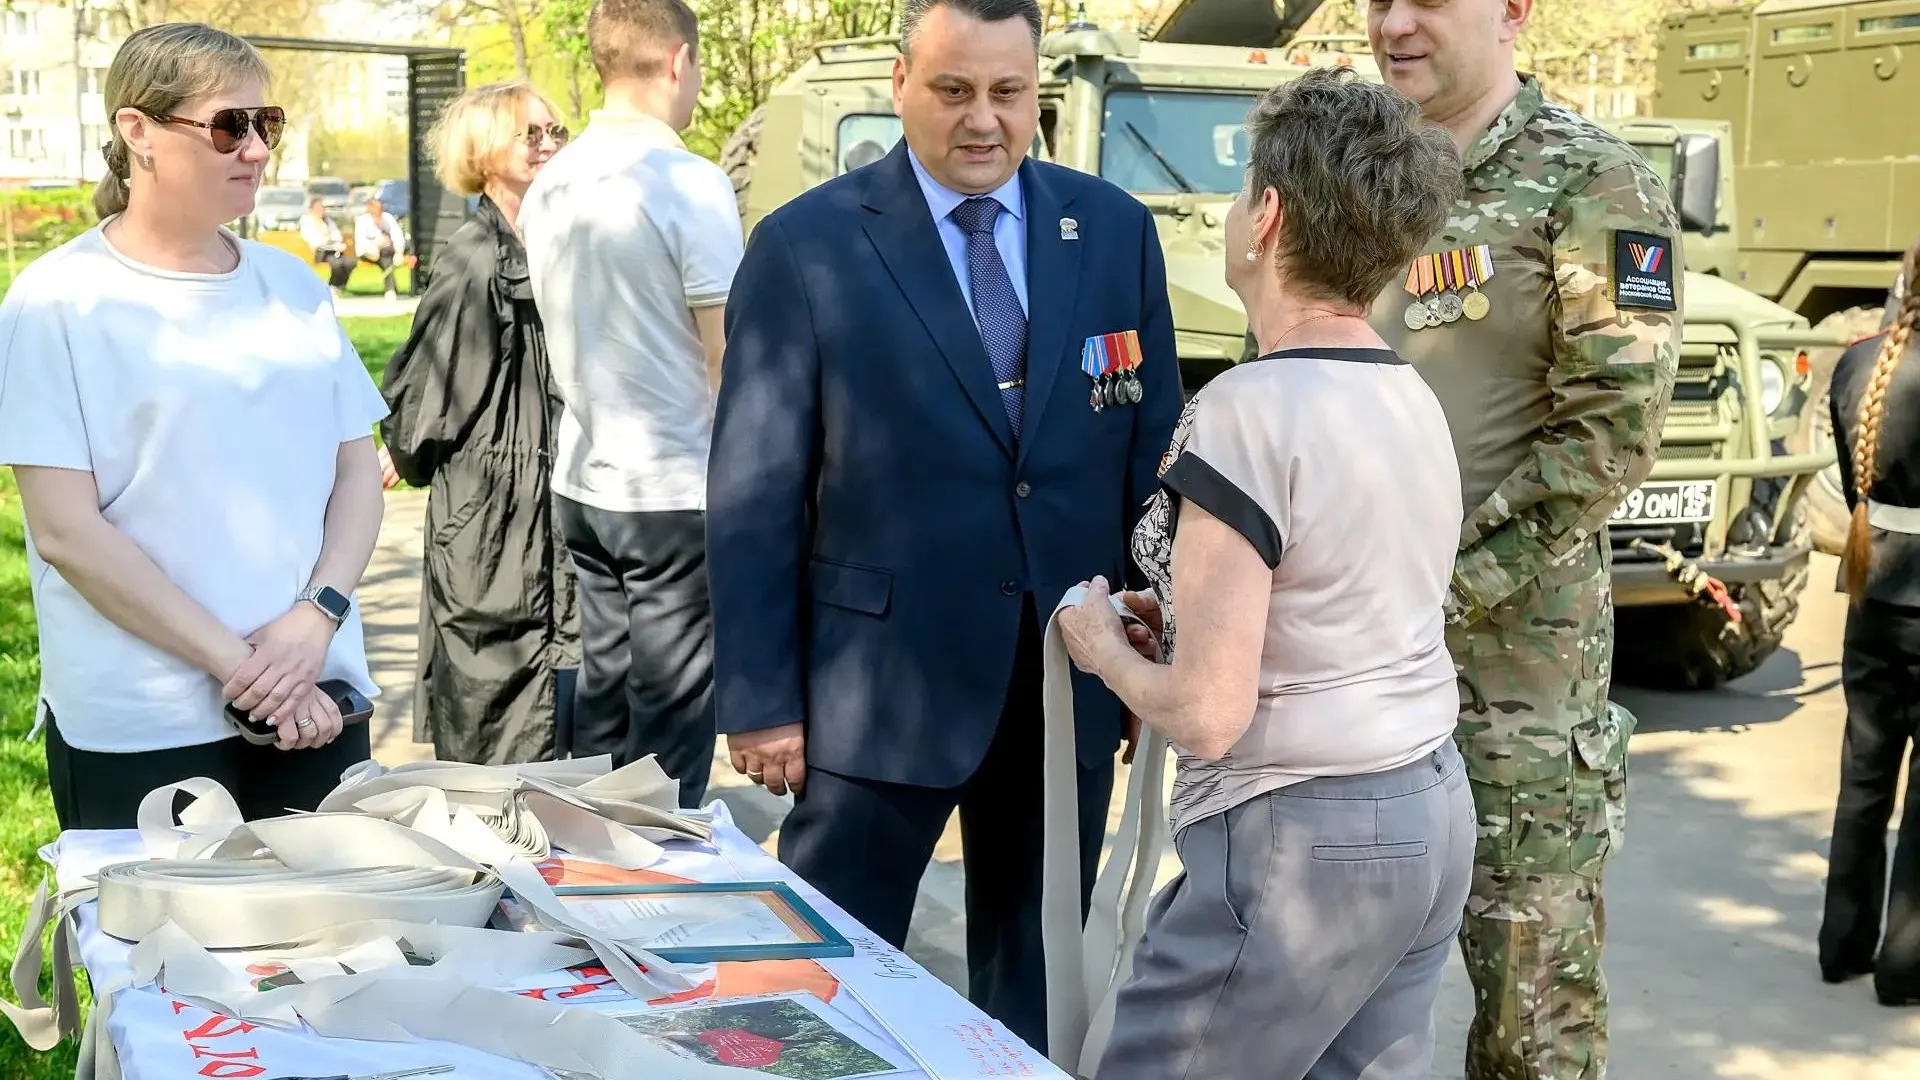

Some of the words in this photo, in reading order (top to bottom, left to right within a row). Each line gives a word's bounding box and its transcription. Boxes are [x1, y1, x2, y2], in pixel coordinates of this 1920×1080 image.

[1626, 275, 1667, 287] Ассоциация
[1620, 282, 1657, 293] ветеранов
[1657, 286, 1671, 295] СВО
[1620, 289, 1652, 299] Московской
[1653, 293, 1672, 301] области
